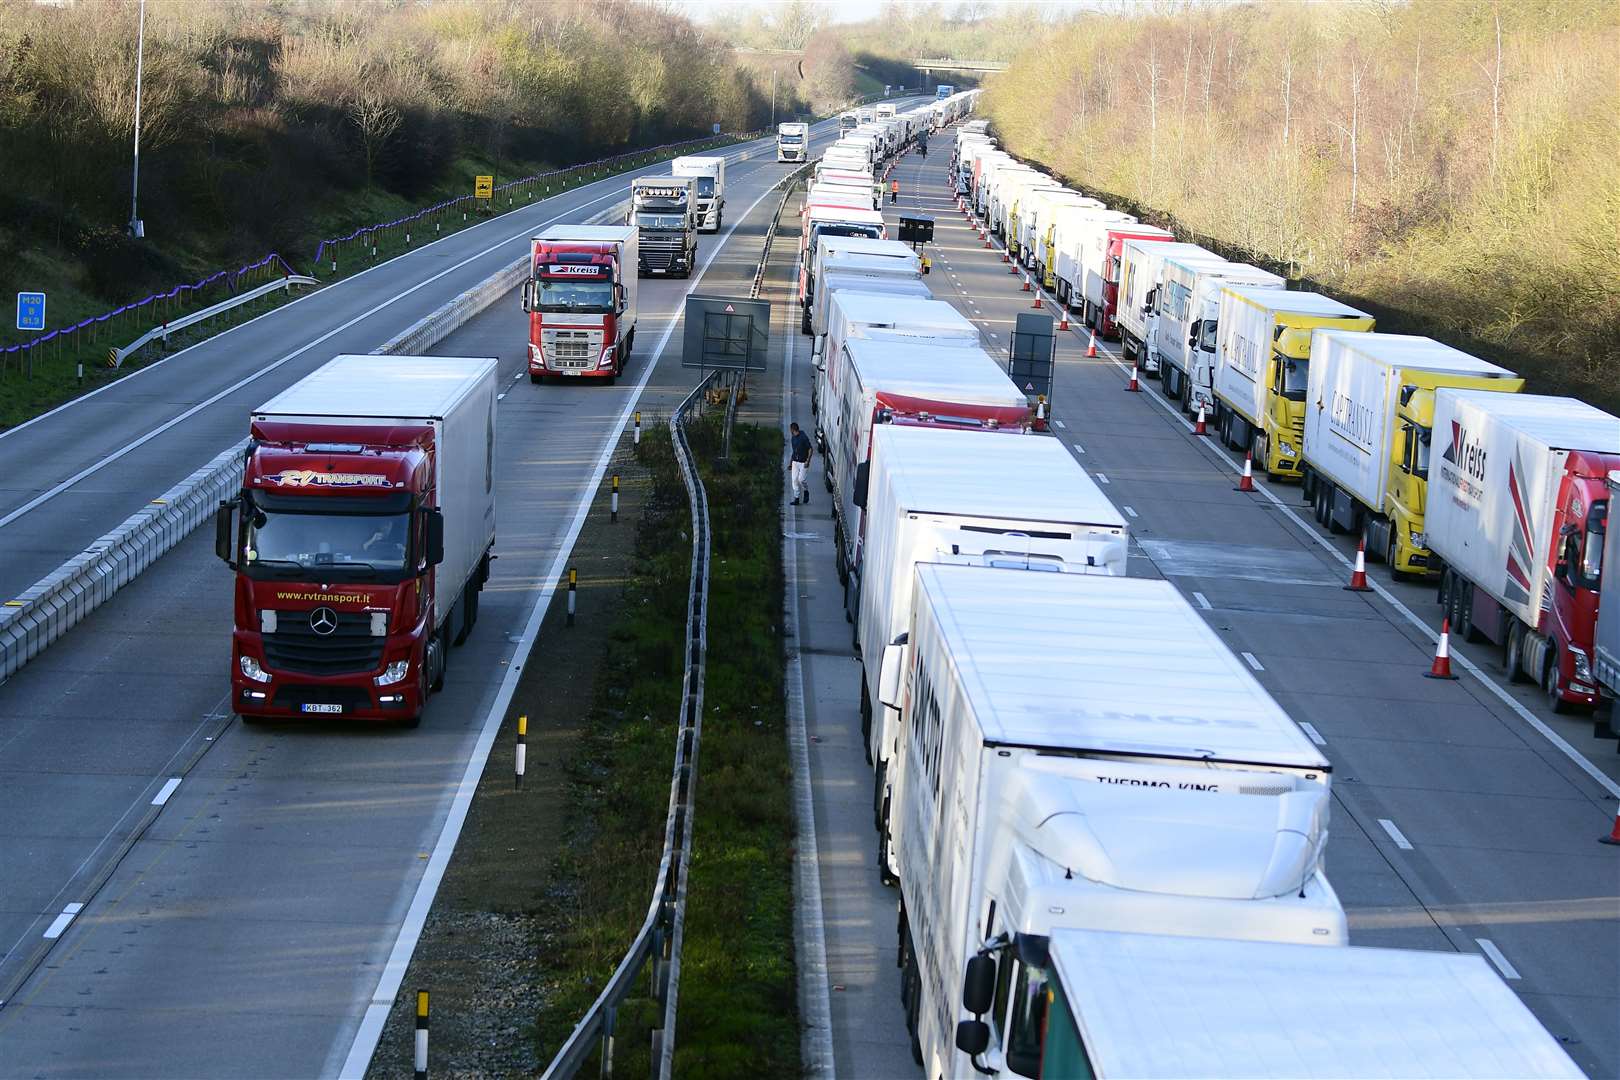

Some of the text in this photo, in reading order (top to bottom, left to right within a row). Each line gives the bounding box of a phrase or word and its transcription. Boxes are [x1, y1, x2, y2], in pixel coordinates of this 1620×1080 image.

[22, 296, 41, 305] M20
[1457, 427, 1487, 482] Kreiss
[316, 472, 386, 485] TRANSPORT
[277, 592, 370, 604] www.rvtransport.lt
